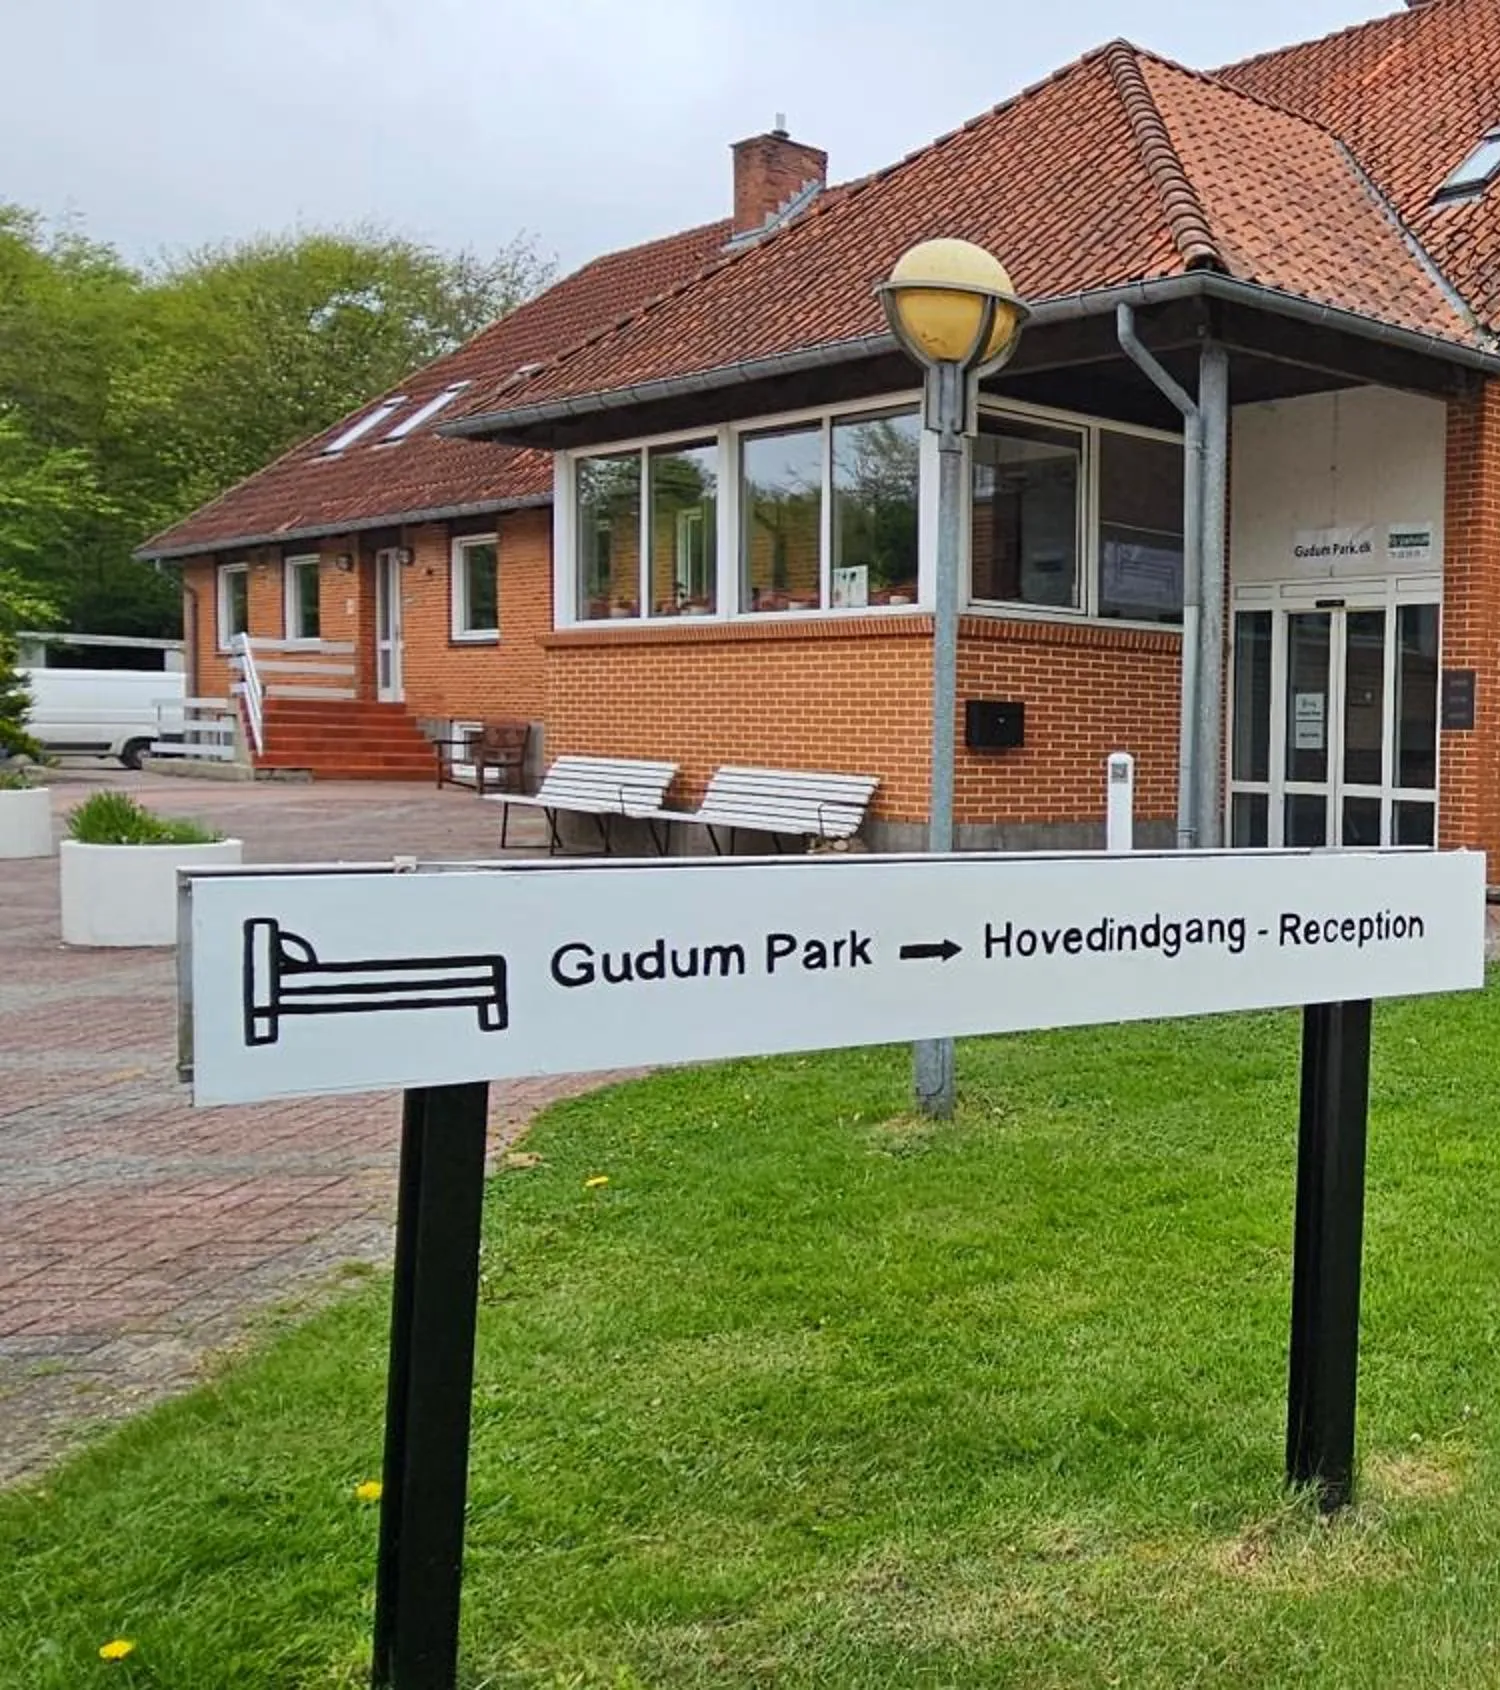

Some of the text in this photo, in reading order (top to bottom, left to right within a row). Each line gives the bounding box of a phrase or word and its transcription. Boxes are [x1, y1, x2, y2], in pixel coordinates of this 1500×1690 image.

[549, 938, 746, 989] Gudum
[765, 929, 874, 975] Park
[983, 913, 1247, 959] Hovedindgang
[1278, 910, 1425, 948] Reception
